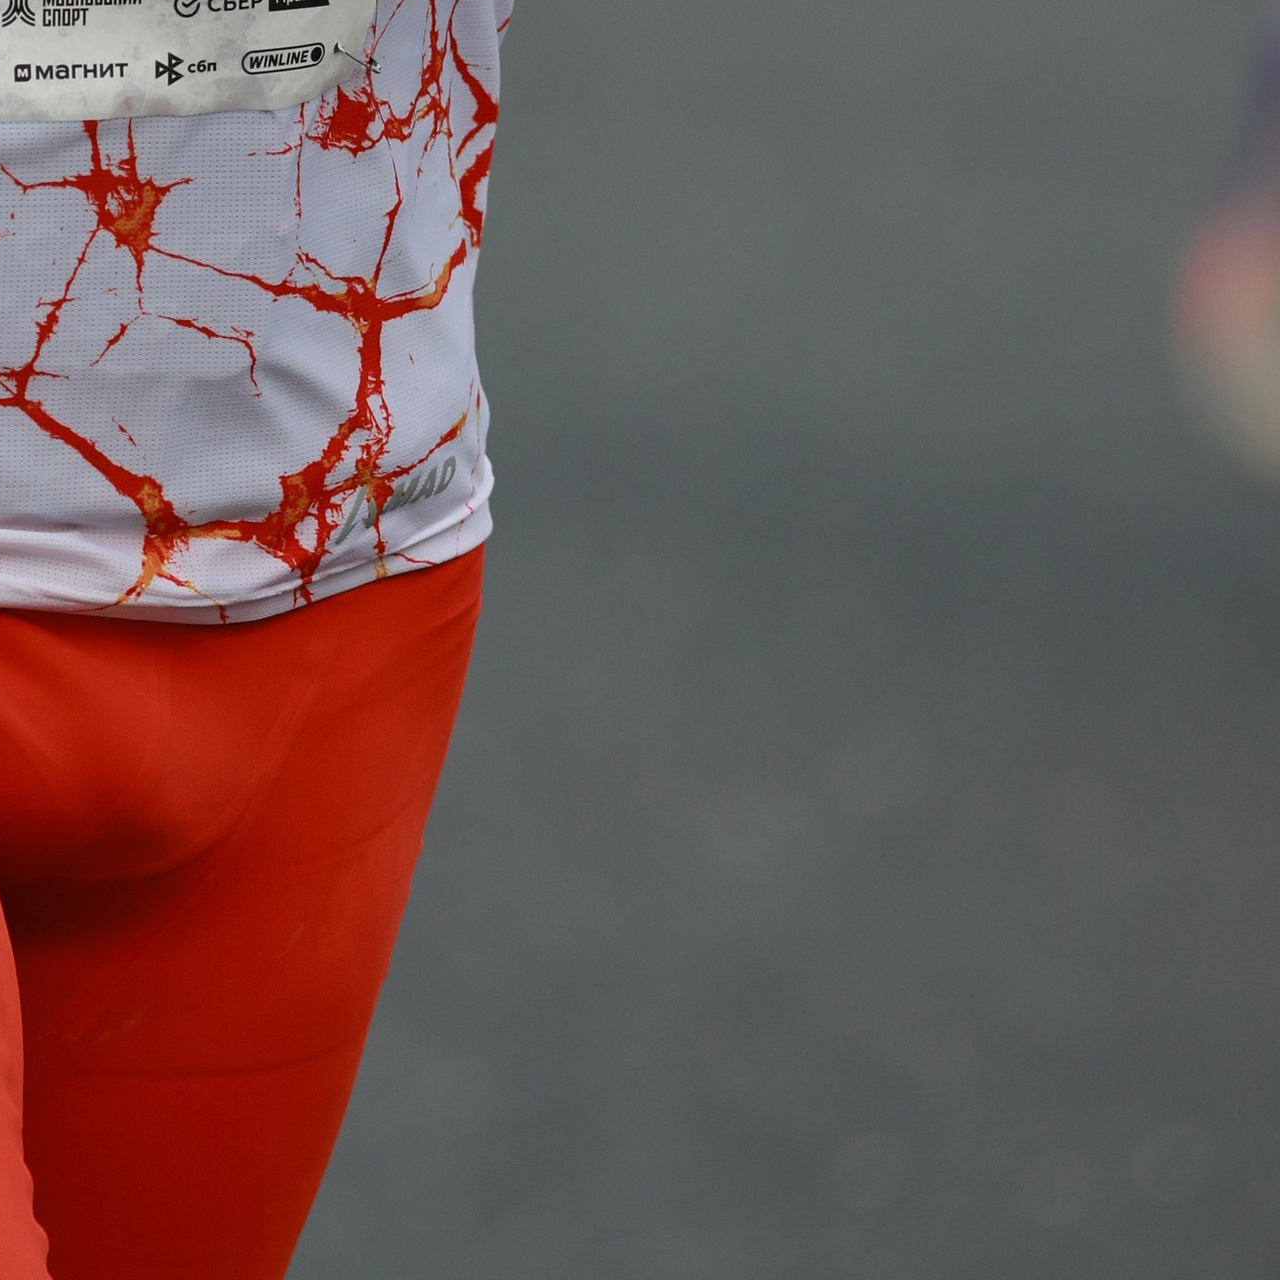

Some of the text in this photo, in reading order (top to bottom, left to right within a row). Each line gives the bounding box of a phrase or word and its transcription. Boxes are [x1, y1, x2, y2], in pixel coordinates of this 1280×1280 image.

[42, 7, 89, 27] СПОРТ
[187, 59, 217, 73] сбп
[249, 50, 310, 70] WINLINE
